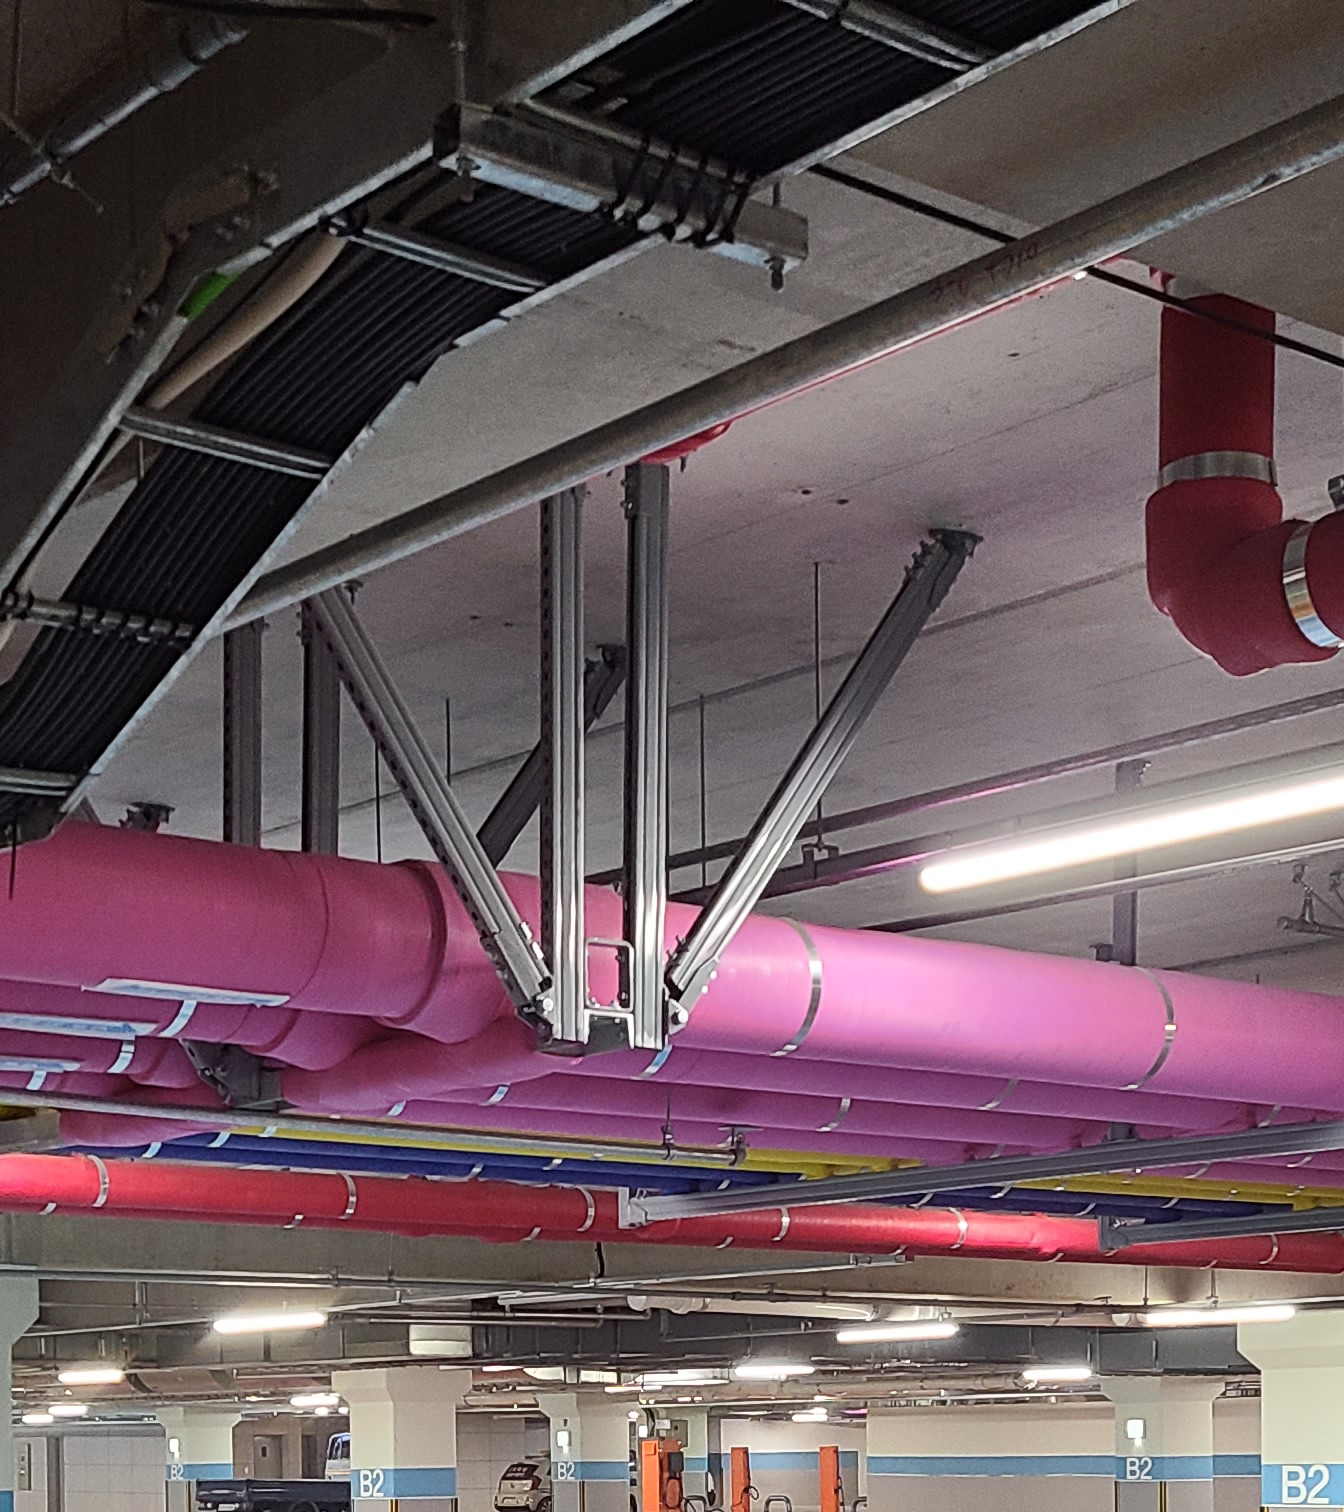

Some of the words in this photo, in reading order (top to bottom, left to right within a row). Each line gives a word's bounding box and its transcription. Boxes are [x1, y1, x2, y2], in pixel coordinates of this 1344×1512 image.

[170, 1464, 184, 1480] B2
[557, 1462, 575, 1480] B2
[1126, 1456, 1153, 1480] B2
[359, 1469, 384, 1497] B2
[1281, 1464, 1330, 1504] B2
